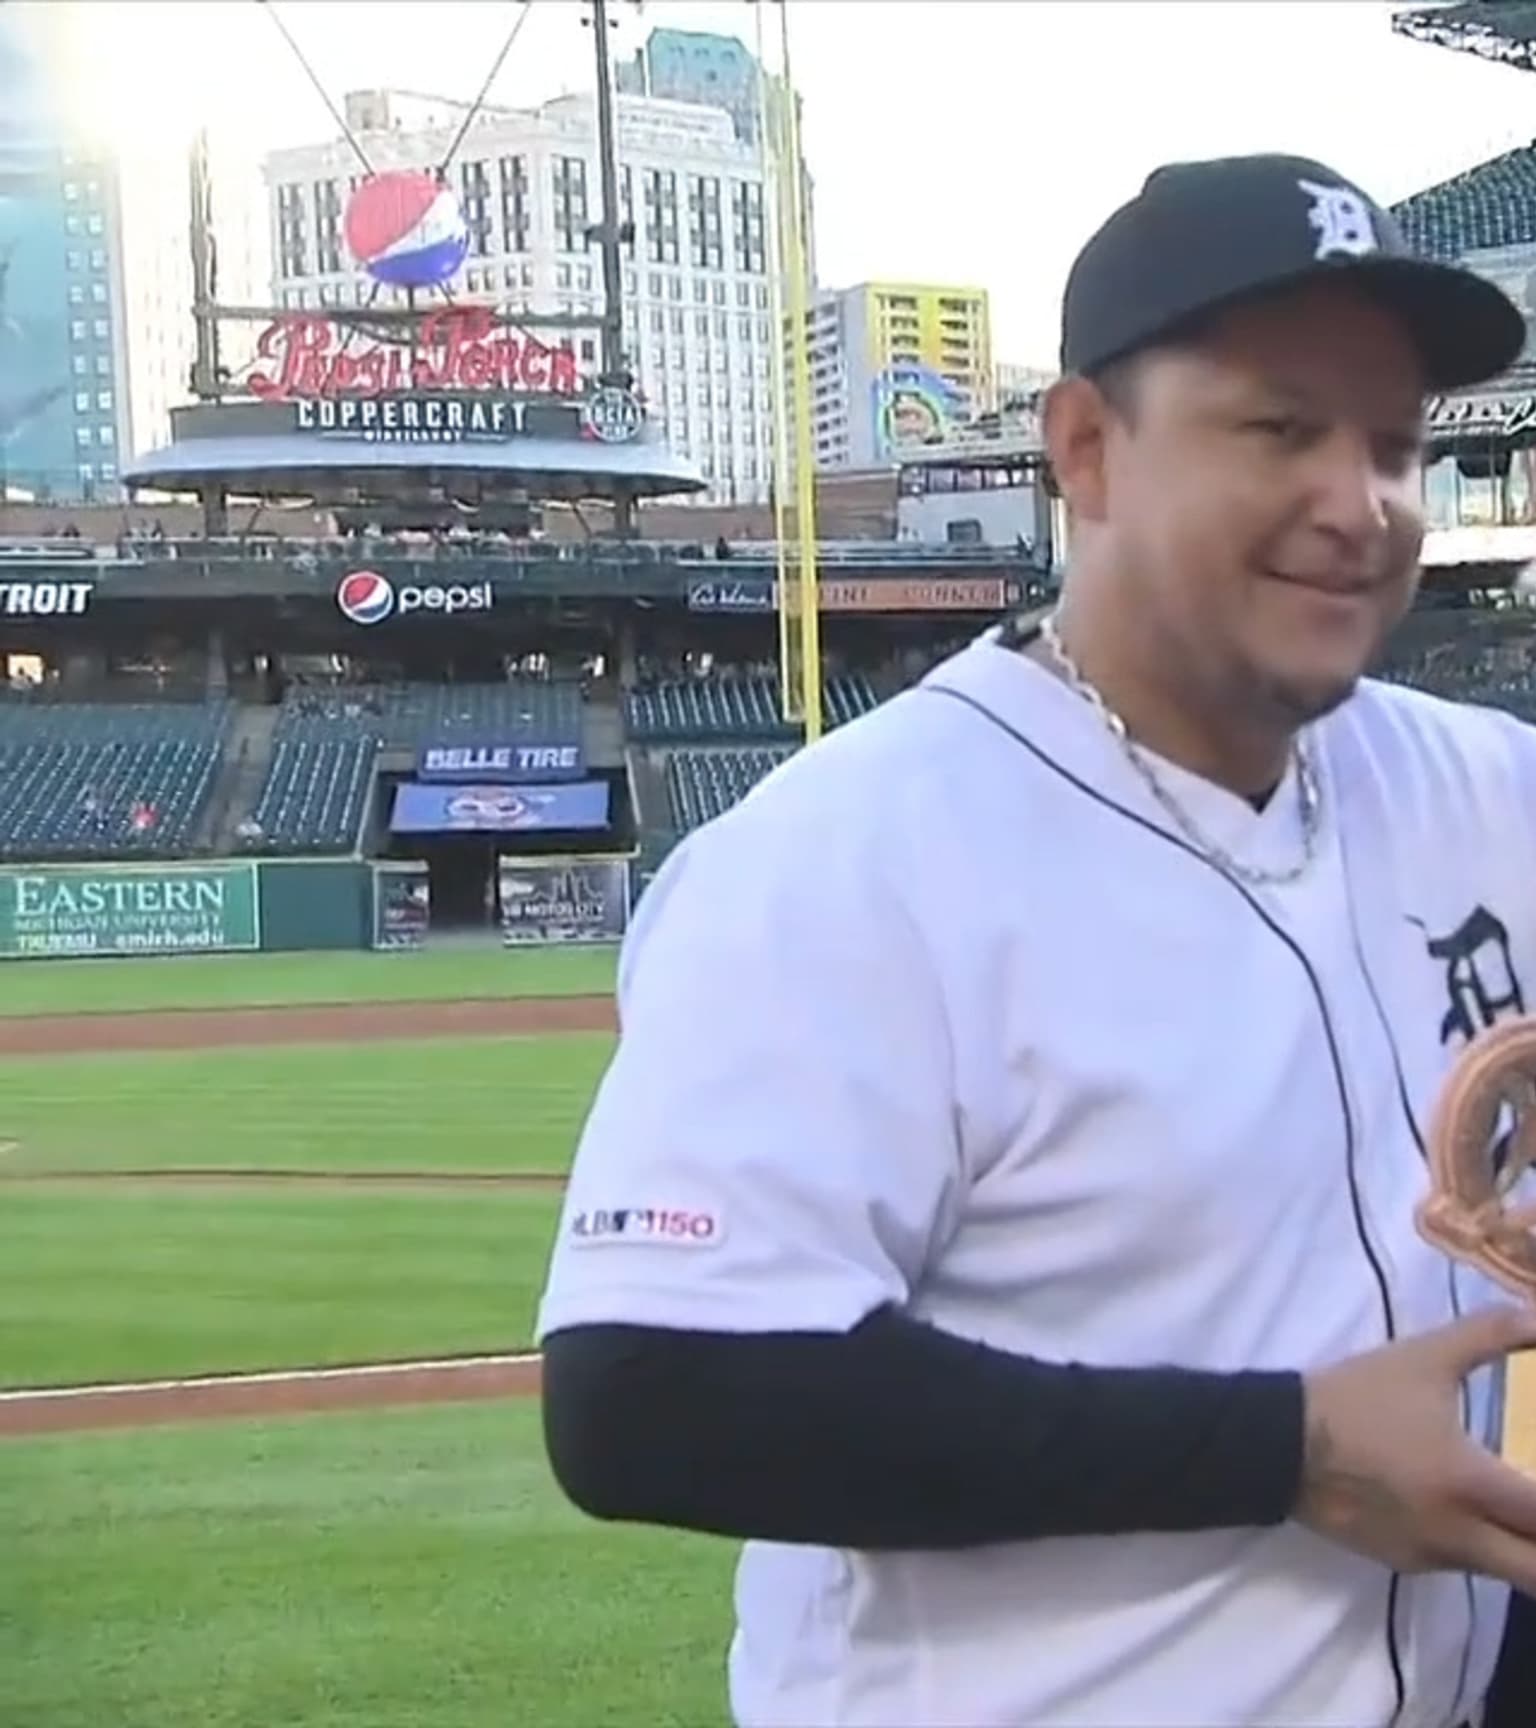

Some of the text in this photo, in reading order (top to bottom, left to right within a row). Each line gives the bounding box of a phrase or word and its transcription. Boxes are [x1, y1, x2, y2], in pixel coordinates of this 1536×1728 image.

[298, 401, 527, 433] COPPERCRAFT
[399, 581, 493, 614] pepsi
[425, 747, 579, 770] BELLE TIRE
[16, 876, 224, 916] EASTERN
